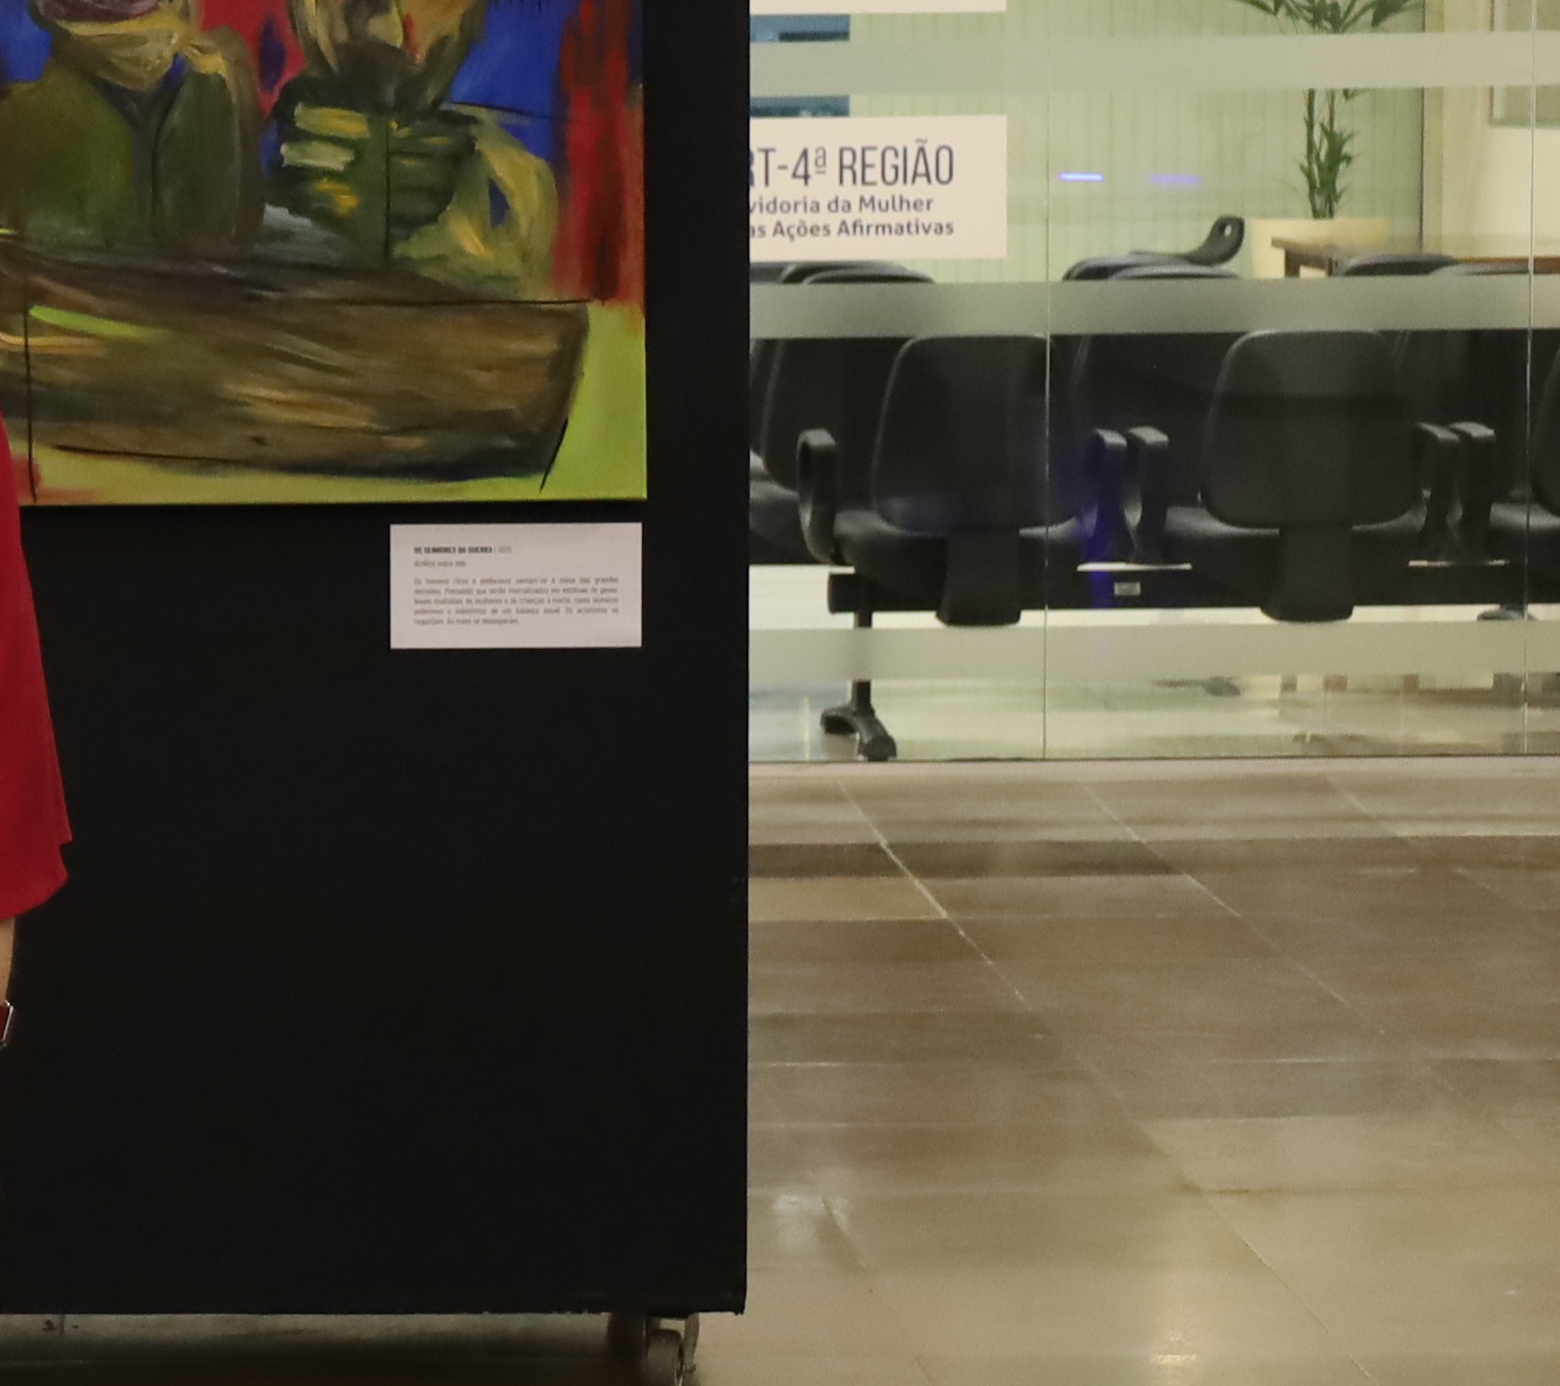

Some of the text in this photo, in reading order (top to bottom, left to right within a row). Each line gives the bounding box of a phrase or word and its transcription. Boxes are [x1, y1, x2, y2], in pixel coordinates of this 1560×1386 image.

[838, 138, 954, 186] REGIÃO
[828, 197, 852, 213] da
[859, 194, 934, 213] Mulher
[772, 219, 831, 242] Ações
[837, 218, 954, 237] Afirmativas
